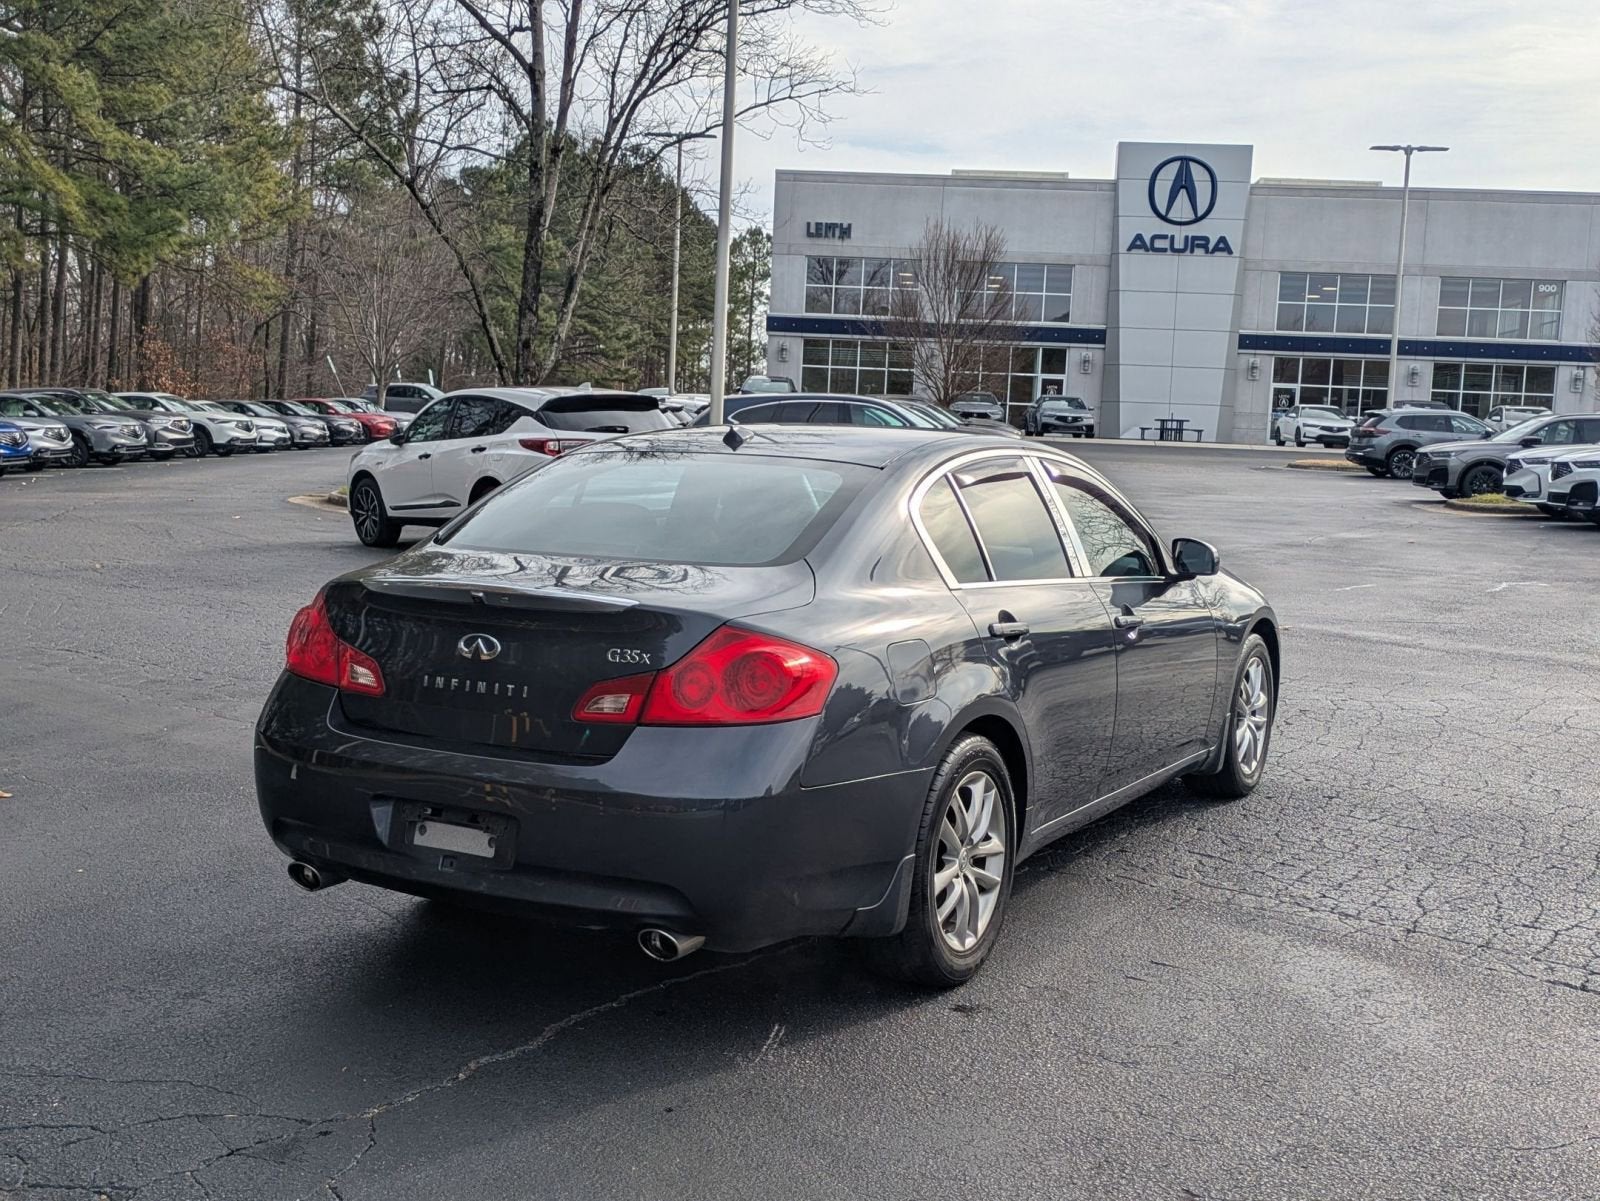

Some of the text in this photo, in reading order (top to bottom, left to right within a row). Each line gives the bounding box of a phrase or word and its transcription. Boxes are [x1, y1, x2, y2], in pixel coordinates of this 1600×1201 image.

[806, 221, 852, 240] LEITH
[1126, 233, 1234, 255] ACURA
[1538, 284, 1557, 293] 900
[607, 648, 651, 665] G35x
[423, 674, 529, 698] INFINITI
